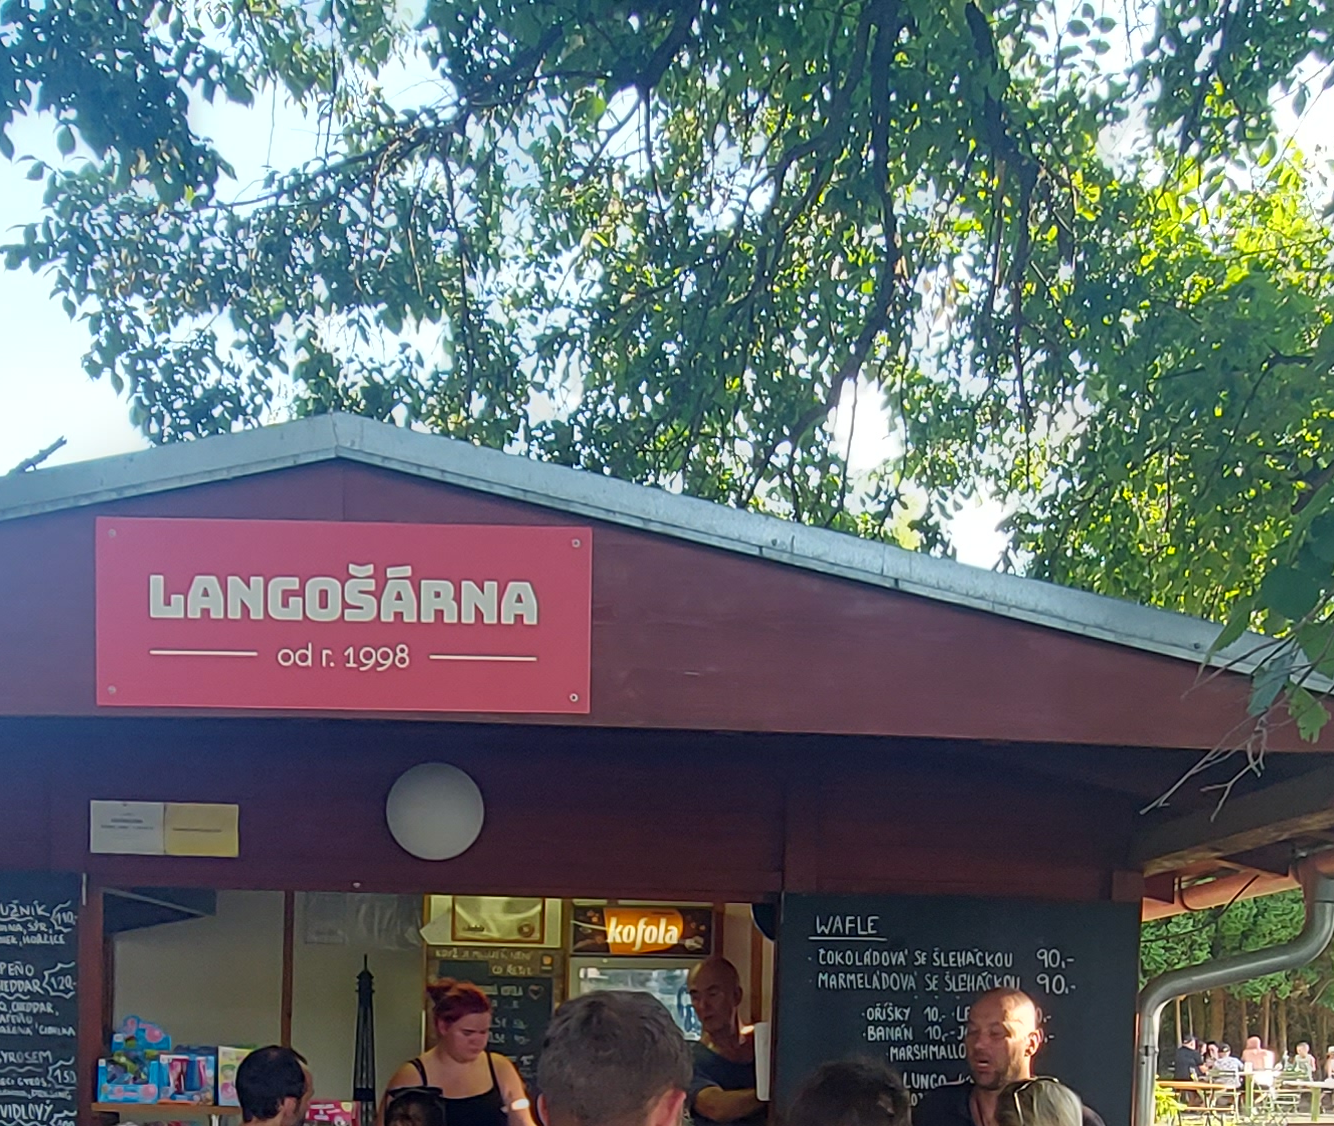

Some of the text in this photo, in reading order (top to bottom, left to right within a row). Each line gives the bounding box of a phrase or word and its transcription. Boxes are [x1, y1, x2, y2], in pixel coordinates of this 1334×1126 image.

[148, 562, 539, 626] LANGOŠÁRNA
[277, 643, 410, 672] od r. 1998
[606, 917, 679, 951] kofola
[816, 915, 879, 935] WAFLE
[818, 948, 908, 966] ČOKOLÁDOVÁ
[913, 949, 927, 965] SE
[818, 971, 917, 991] MARMELÁDOVÁ
[924, 973, 939, 991] SE
[867, 1002, 911, 1021] OŘÍŠKY
[867, 1025, 913, 1041] BANÁN
[890, 1043, 967, 1062] MARSHMALLO
